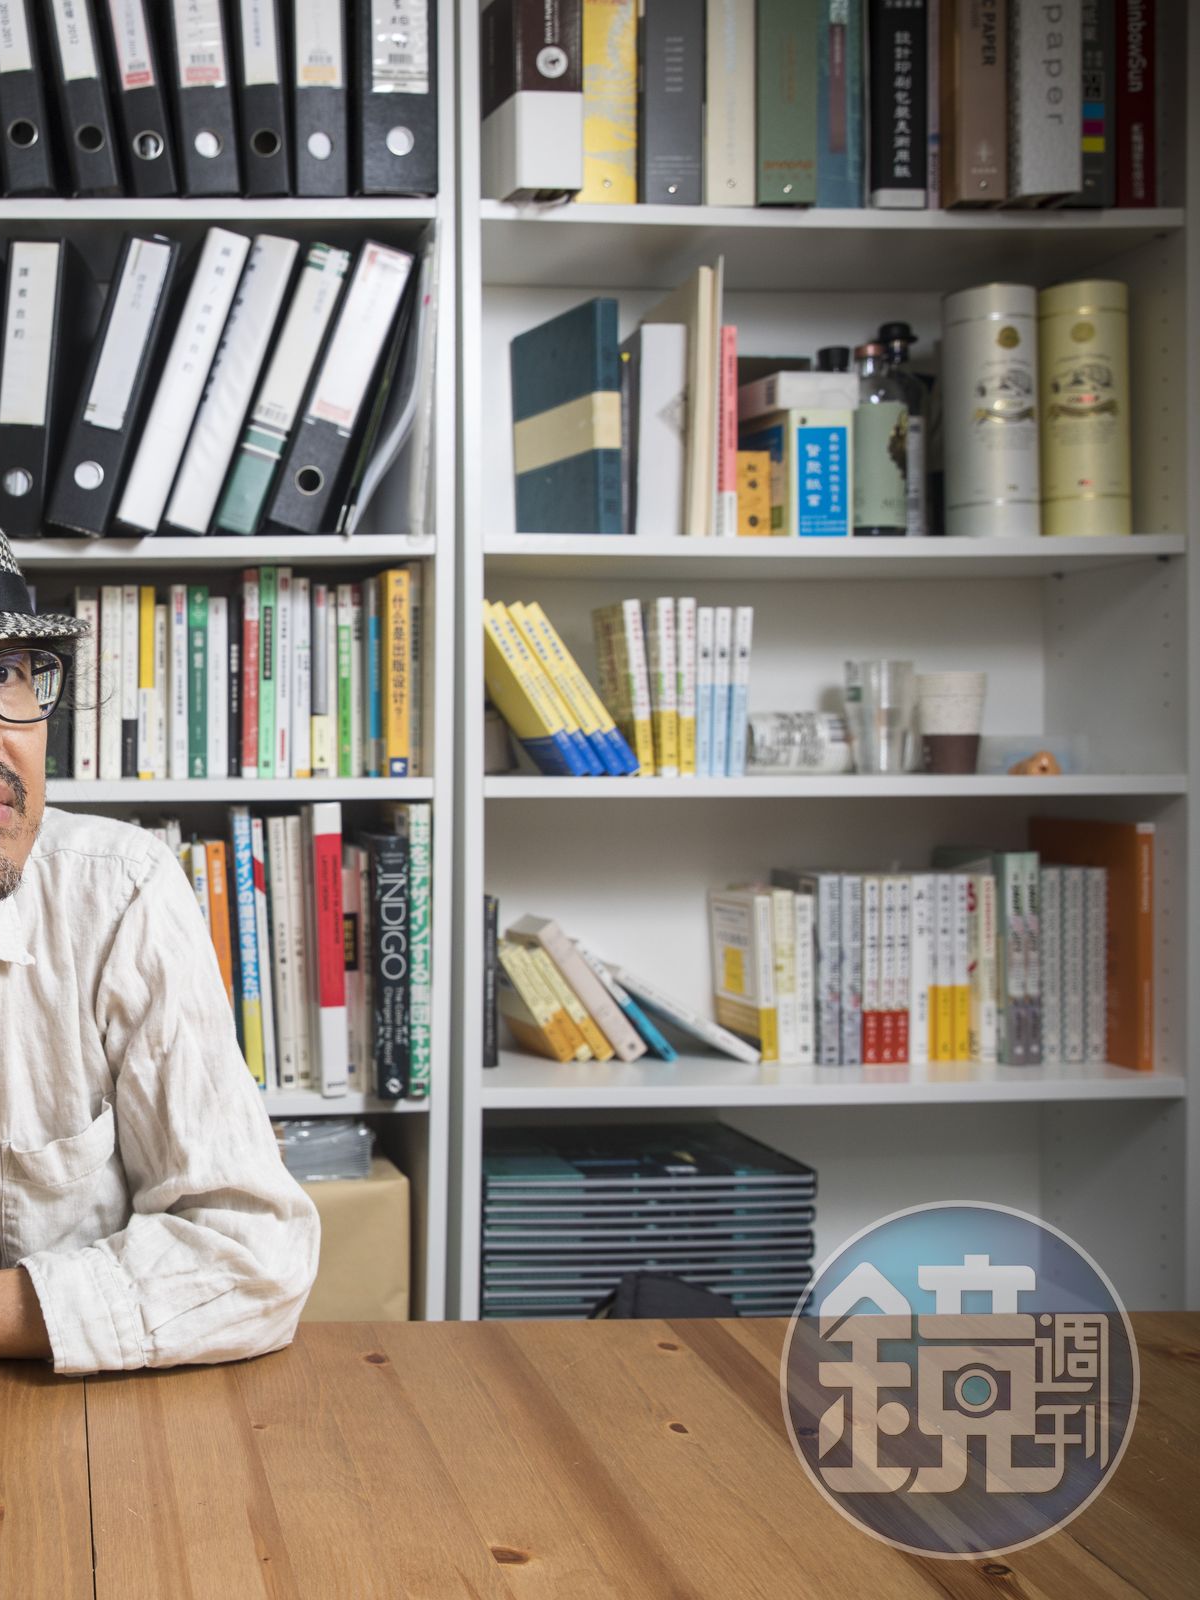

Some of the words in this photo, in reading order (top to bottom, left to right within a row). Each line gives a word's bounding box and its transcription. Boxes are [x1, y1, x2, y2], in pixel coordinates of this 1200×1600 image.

[981, 14, 997, 67] PAPER
[1043, 4, 1064, 125] paper
[380, 873, 407, 980] INDIGO
[383, 986, 393, 1025] Changed
[395, 986, 404, 1002] The
[384, 1040, 393, 1065] World
